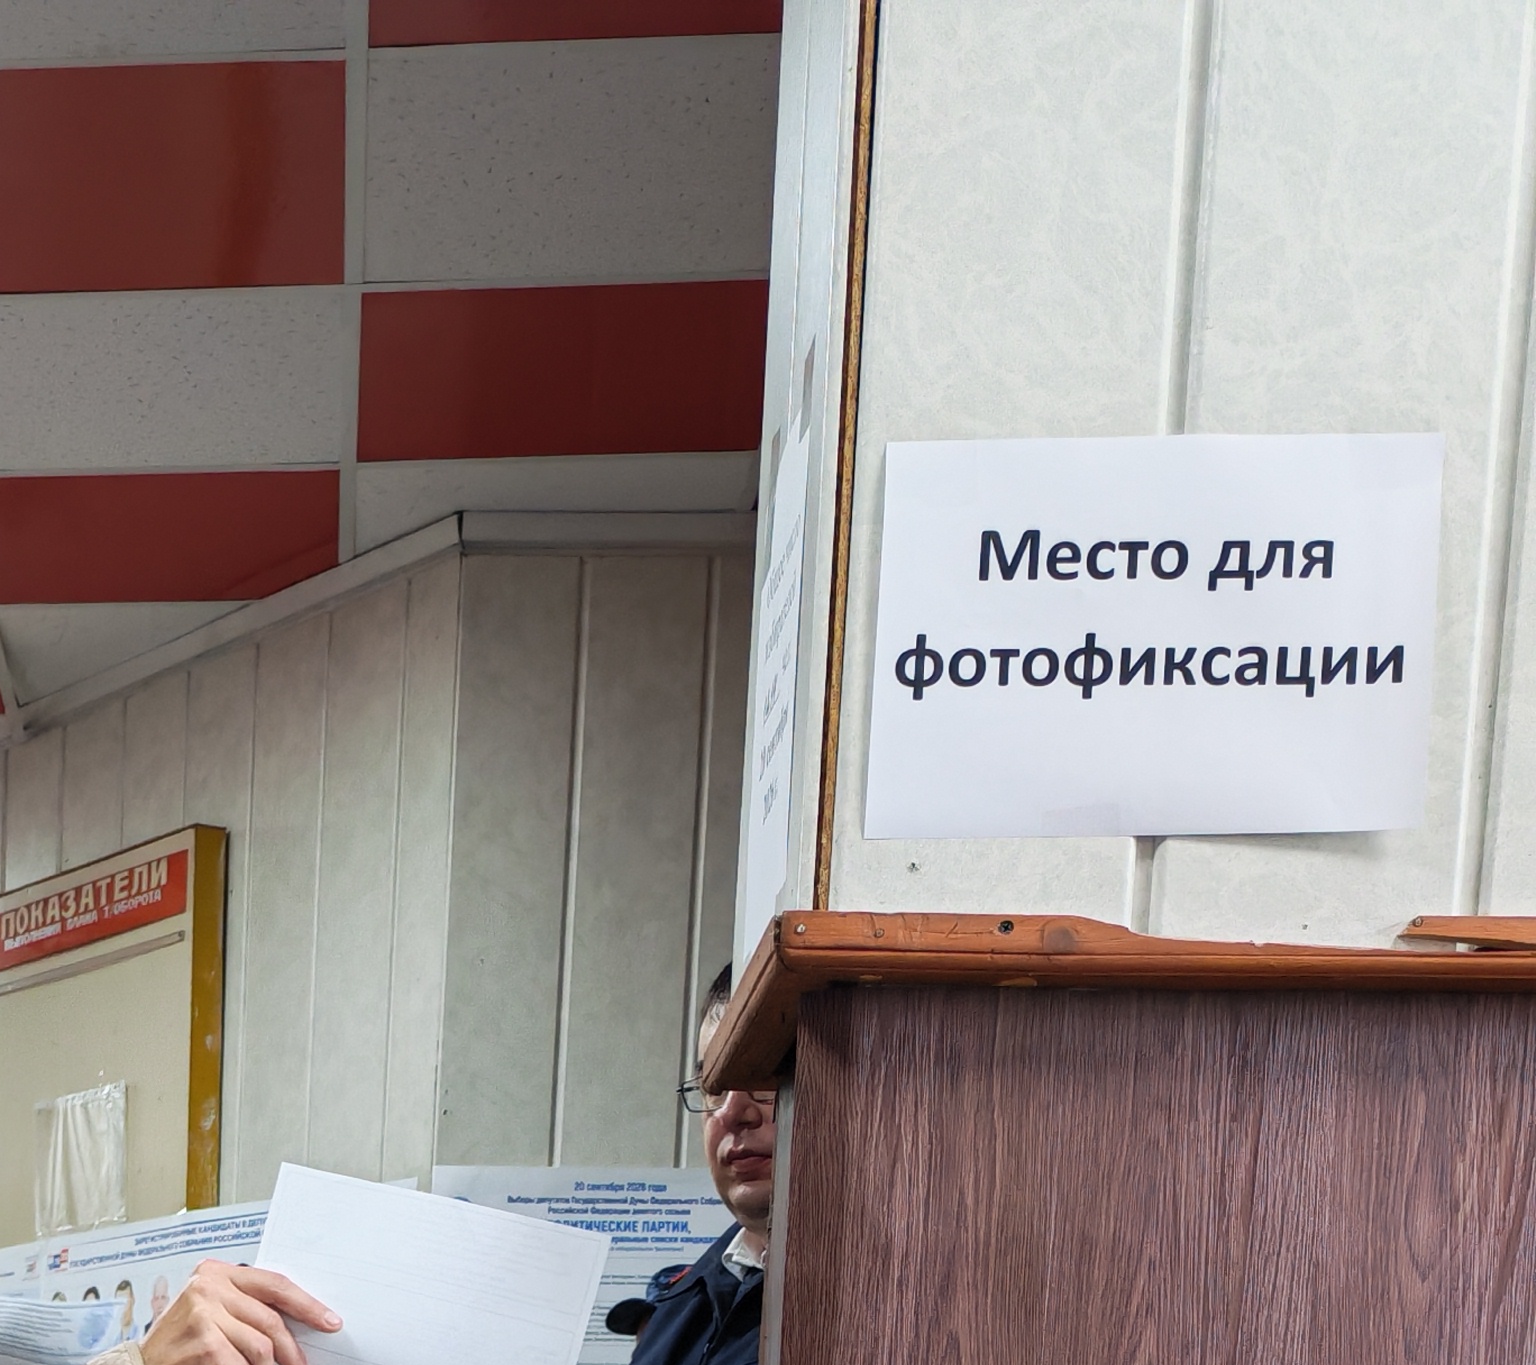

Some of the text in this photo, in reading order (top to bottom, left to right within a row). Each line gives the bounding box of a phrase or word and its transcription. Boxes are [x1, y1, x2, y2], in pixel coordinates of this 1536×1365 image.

[979, 530, 1334, 592] Место для
[895, 633, 1404, 701] фотофиксации
[0, 857, 169, 940] ПОКАЗАТЕЛИ
[587, 1181, 625, 1193] сентября
[198, 1220, 241, 1234] КАНДИДАТЫ
[548, 1219, 691, 1234] ИТИЧЕСКИЕ ПАРТИИ,
[213, 1228, 261, 1243] РОССИЙСКОЙ
[680, 1237, 721, 1245] кандидат
